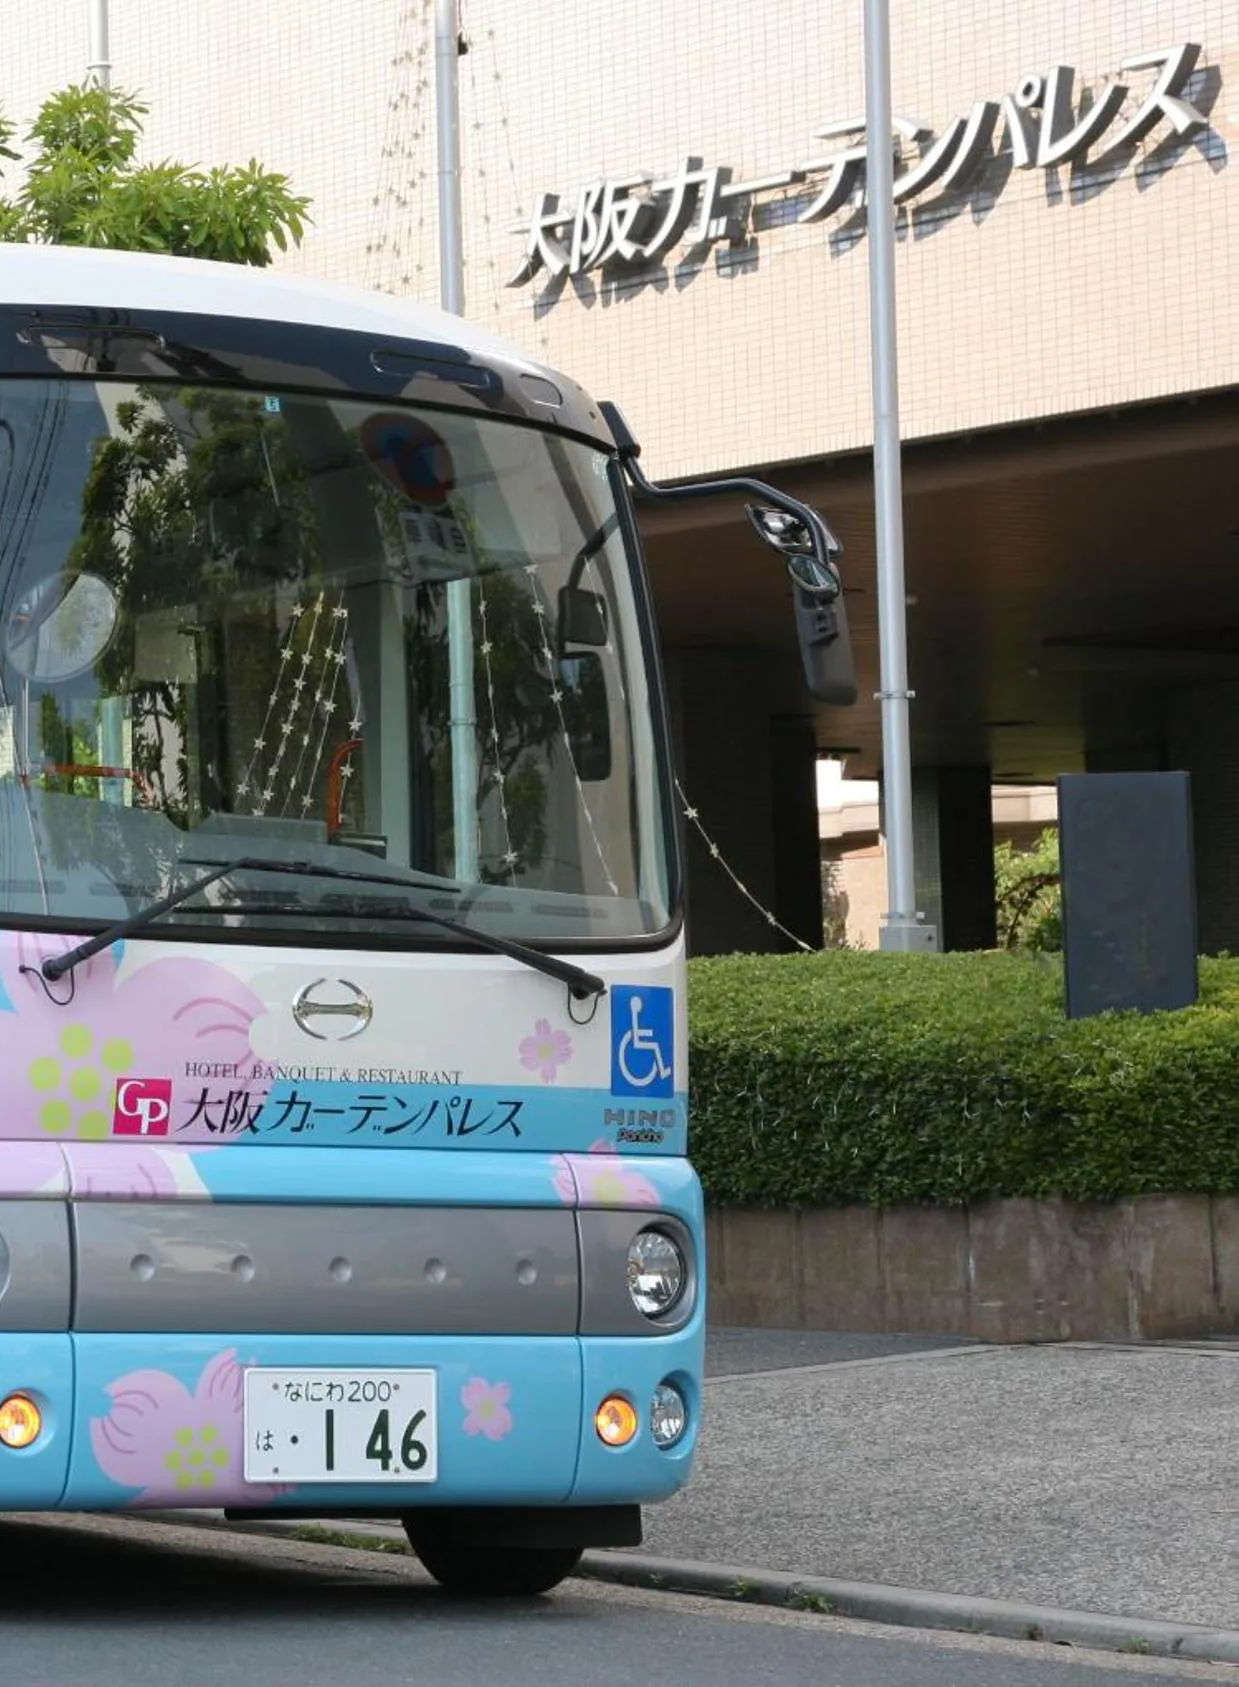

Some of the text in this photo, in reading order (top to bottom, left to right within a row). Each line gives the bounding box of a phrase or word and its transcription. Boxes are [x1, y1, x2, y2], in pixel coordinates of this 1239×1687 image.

[252, 1065, 337, 1083] BANQUET
[340, 1068, 350, 1082] &
[358, 1068, 463, 1085] RESTAURANT
[175, 1086, 523, 1138] 大阪ガーデンパレス
[603, 1108, 676, 1127] HINO
